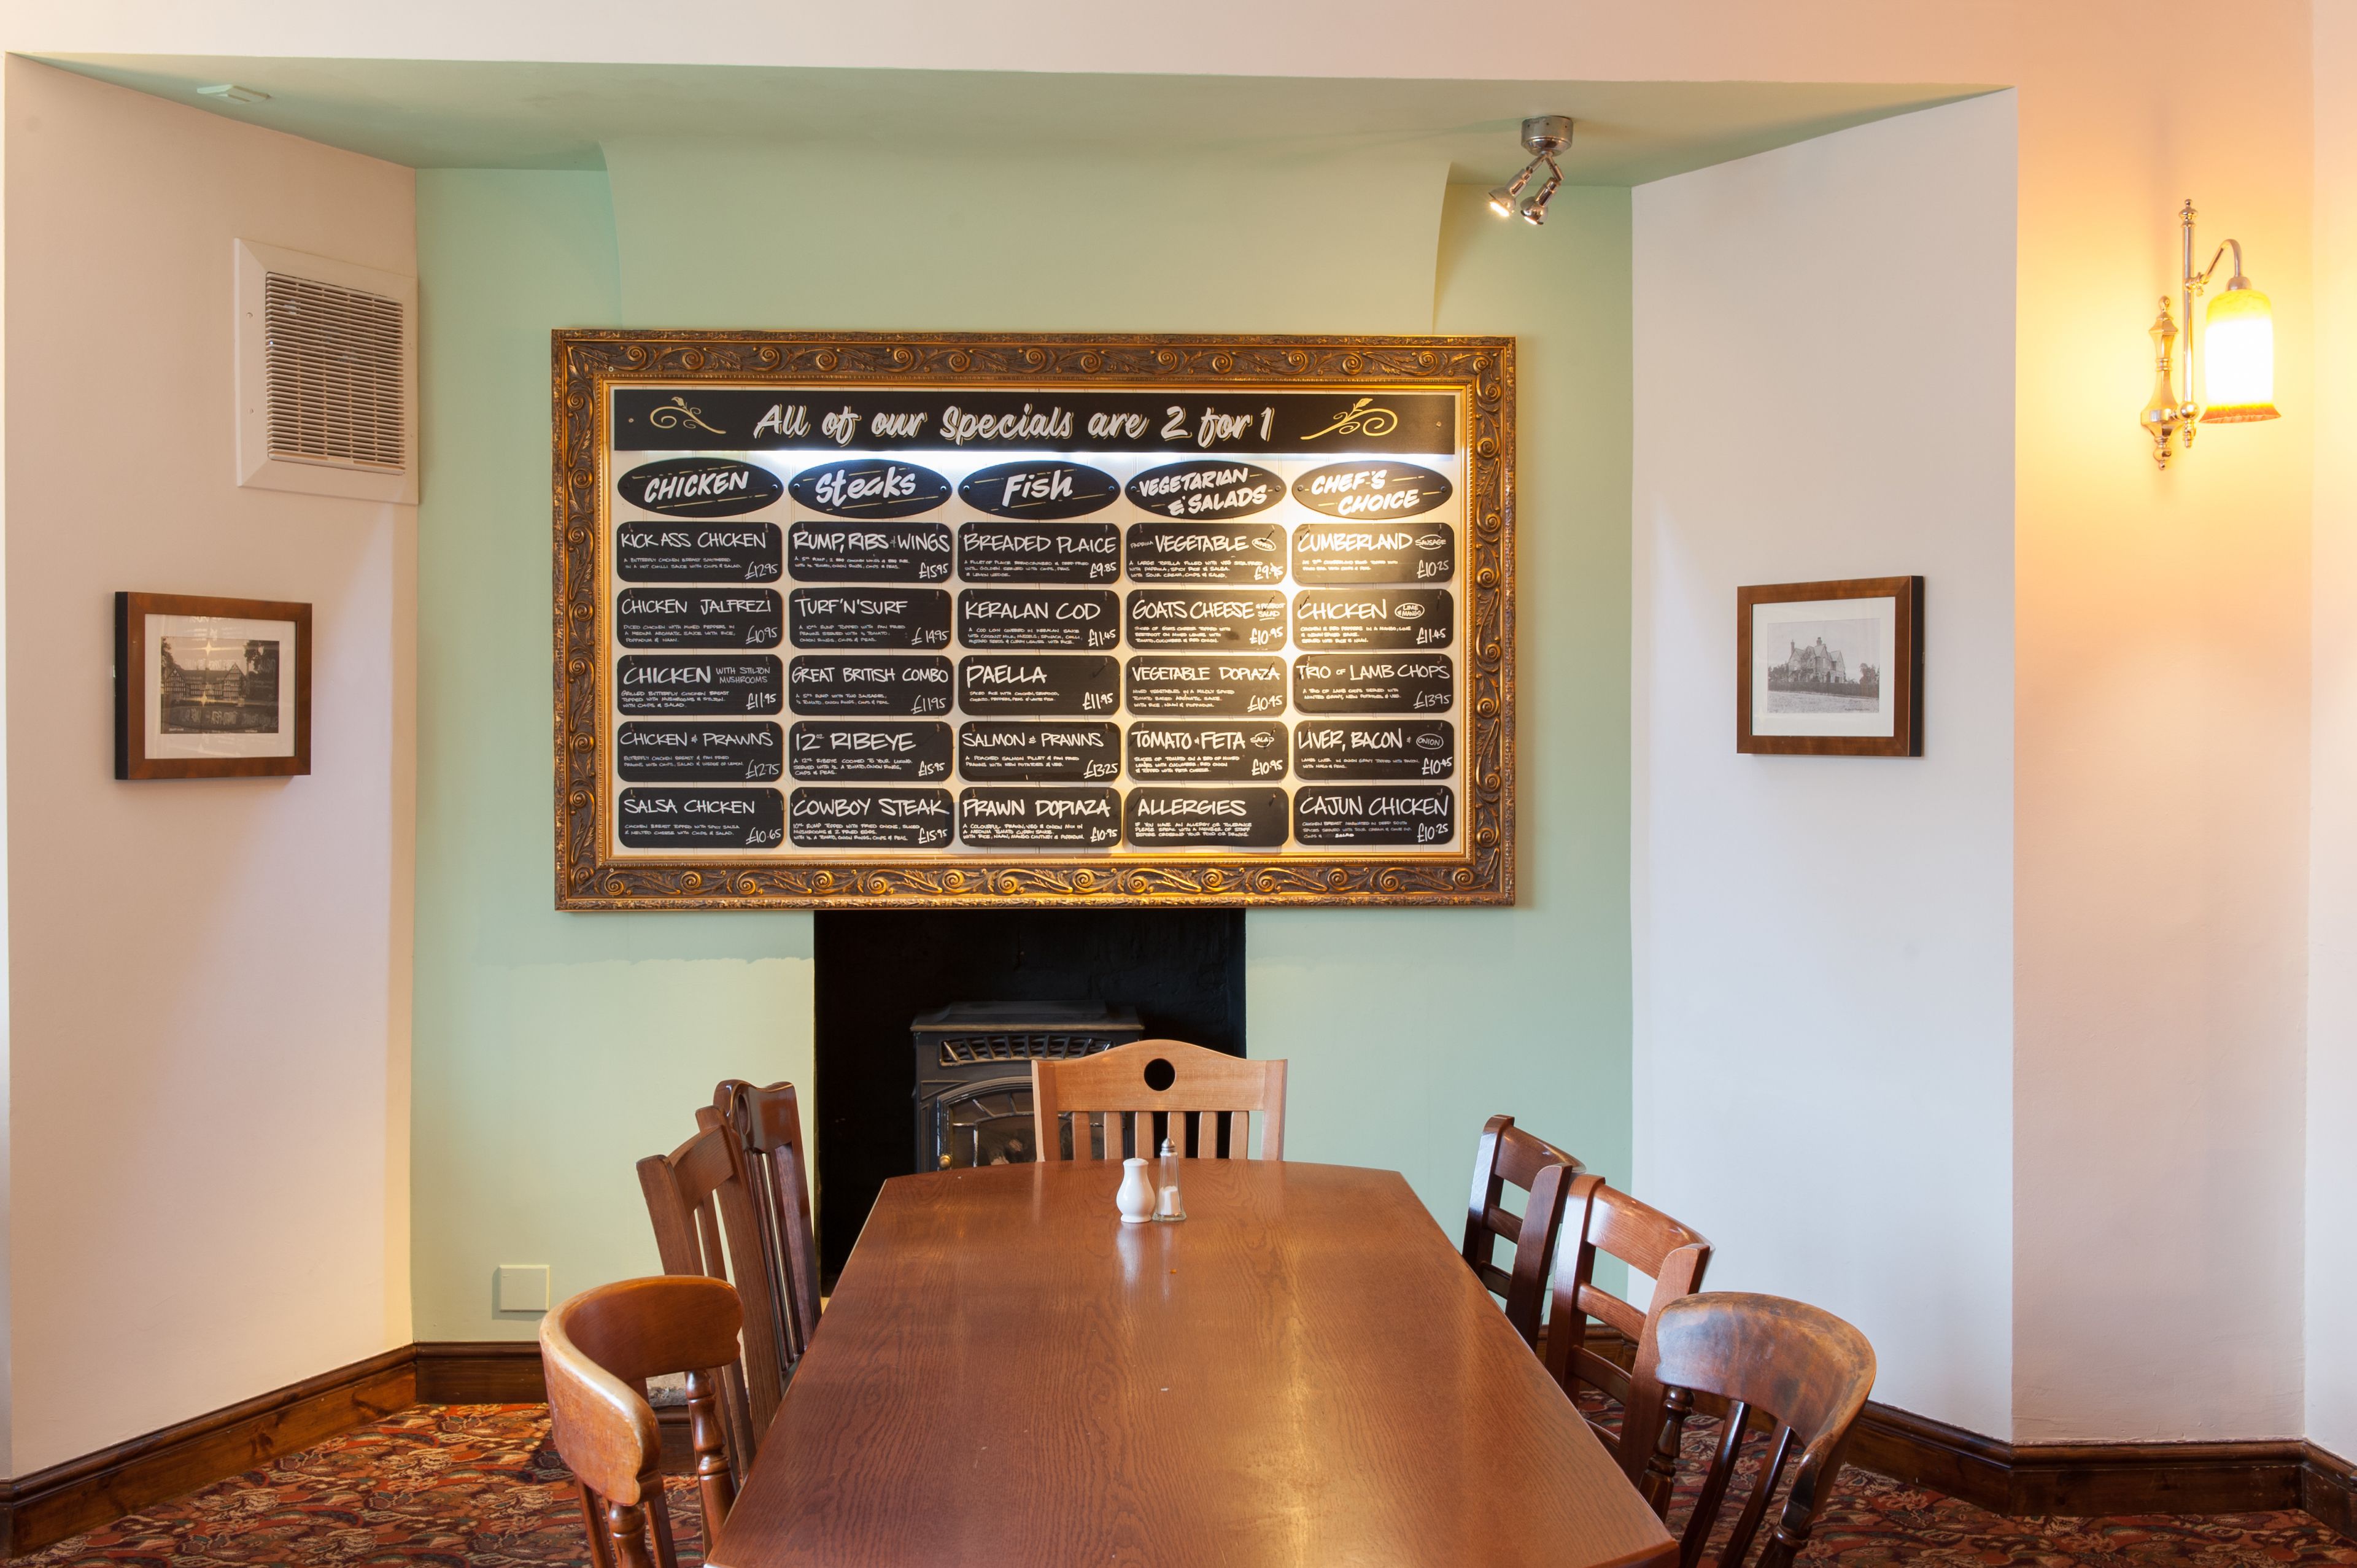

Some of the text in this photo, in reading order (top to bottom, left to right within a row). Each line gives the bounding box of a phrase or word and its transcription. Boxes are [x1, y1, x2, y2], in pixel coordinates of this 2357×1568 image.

[754, 403, 1274, 448] All of our Specials are 2 for 1
[644, 470, 748, 503] CHICKEN
[816, 466, 916, 509] Steaks
[1001, 469, 1074, 508] Fish
[1138, 468, 1248, 498] VEGETARIAN
[1312, 469, 1387, 495] CHEF'S
[1338, 489, 1419, 515] CHOICE
[621, 532, 765, 548] KICK ASS CHICKEN
[793, 530, 845, 553] RUMP,
[848, 533, 889, 550] RIBS
[898, 533, 950, 552] WINGS
[964, 533, 1116, 554] BREADED PLAICE
[1155, 535, 1249, 552] VEGETABLE
[1298, 533, 1412, 552] CUMBERLAND
[1090, 562, 1117, 578] £9.85
[1417, 560, 1449, 578] £10.25
[622, 599, 771, 615] CHICKEN JALFREZI
[794, 598, 908, 617] TURF'N'SURF
[966, 601, 1101, 620] KERALAN COD
[1132, 600, 1188, 619] GOATS
[1190, 601, 1255, 619] CHEESE
[1297, 598, 1387, 620] CHICKEN
[746, 625, 777, 644] £10.95
[1250, 626, 1285, 645] £10.95
[1416, 627, 1446, 644] £11.45
[624, 666, 711, 684] CHICKEN
[792, 666, 948, 683] GREAT BRITISH COMBO
[967, 665, 1047, 688] PAELLA
[1132, 667, 1282, 681] VEGETABLE DOPIAZA
[1296, 665, 1331, 679] TRIO
[1350, 665, 1395, 681] LAMB
[1397, 665, 1450, 678] CHOPS
[1247, 695, 1282, 713] £10.45
[621, 732, 687, 746] CHICKEN
[703, 732, 773, 746] PRAWNS
[830, 733, 916, 751] RIBEYE
[962, 733, 1025, 746] SALMON
[1042, 733, 1104, 747] PRAWNS
[1131, 731, 1192, 749] TOMATO
[1201, 732, 1245, 749] FETA
[1298, 729, 1345, 751] LIVER,
[1351, 728, 1402, 749] BACON
[918, 761, 945, 776] £15.95
[1083, 760, 1118, 779] £13.25
[1252, 759, 1283, 776] £10.95
[1422, 757, 1452, 774] £10.45
[624, 799, 754, 814] SALSA CHICKEN
[793, 798, 949, 817] COWBOY STEAK
[963, 799, 1110, 819] PRAWN DOPIAZA
[1138, 799, 1246, 816] ALLERGIES
[1300, 795, 1448, 816] CAJUN CHICKEN
[746, 827, 781, 845] £10.65
[918, 828, 947, 844] £15.95
[1090, 827, 1118, 842] £10.95
[1417, 823, 1448, 843] £10.25
